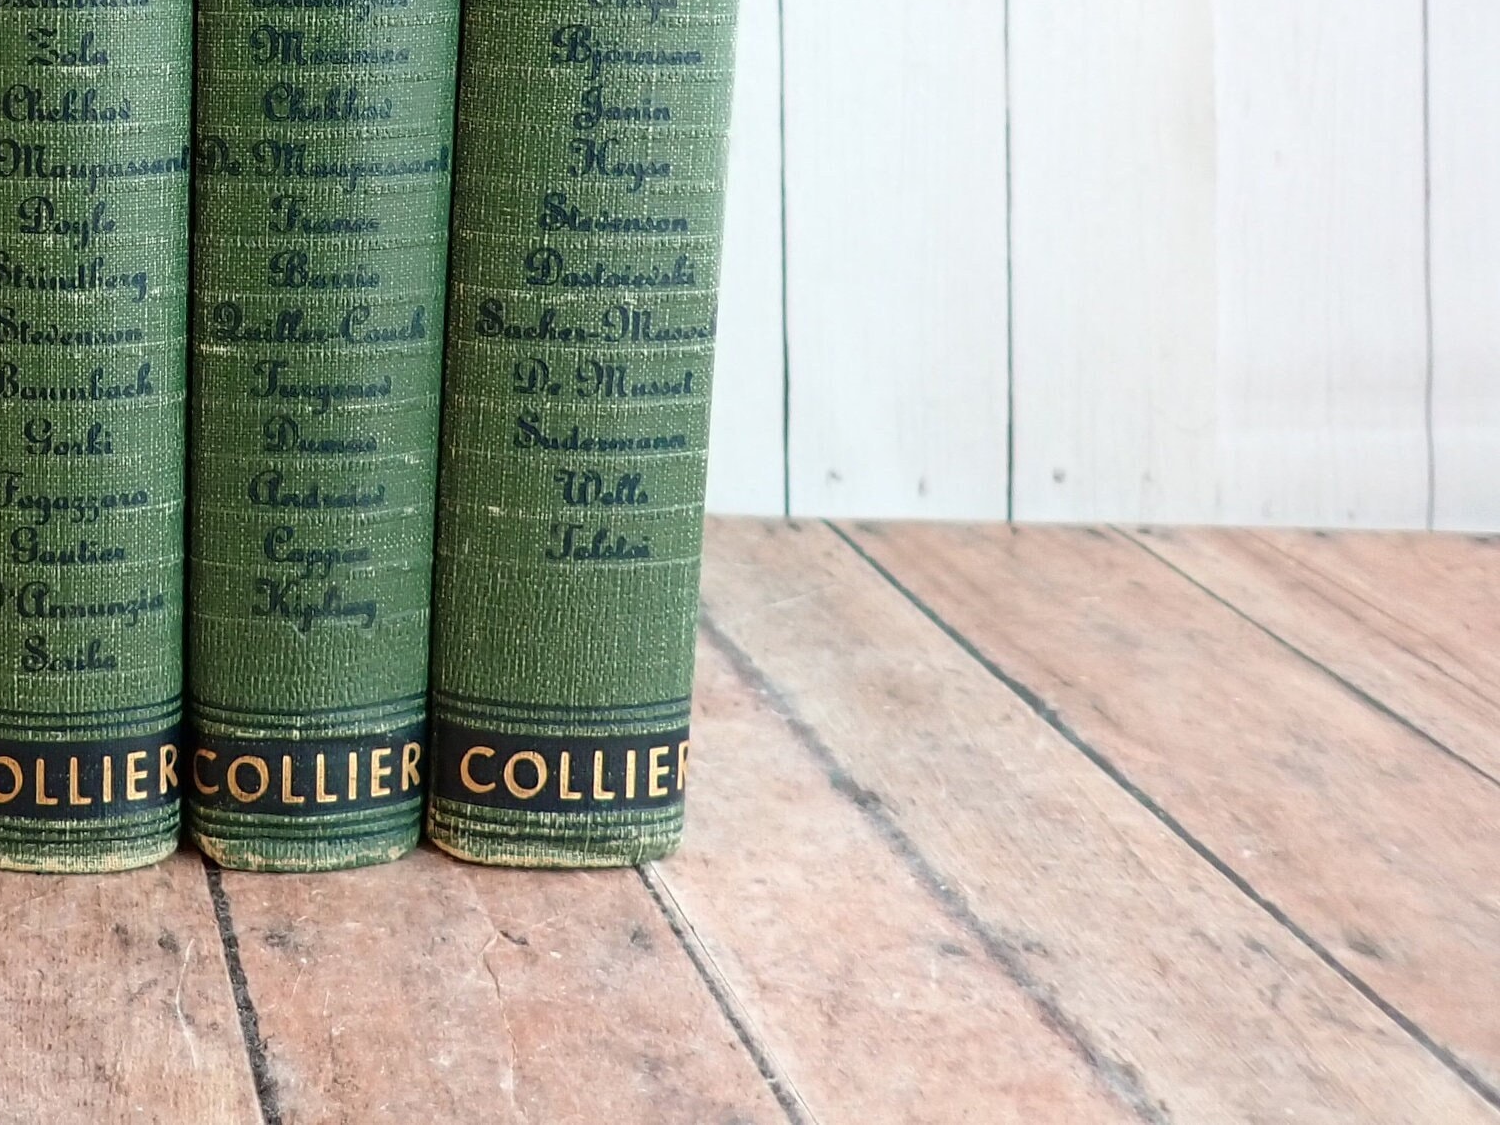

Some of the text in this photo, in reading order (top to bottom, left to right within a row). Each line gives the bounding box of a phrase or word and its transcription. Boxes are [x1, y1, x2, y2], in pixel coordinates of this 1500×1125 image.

[26, 26, 109, 66] Zola
[2, 83, 132, 123] Chekhov
[18, 196, 116, 250] Doyle
[539, 192, 689, 233] Stevenson
[513, 357, 562, 395] De
[23, 418, 114, 456] Gorki
[513, 411, 686, 450] Sudermann
[553, 469, 649, 506] Wells
[9, 526, 126, 566] Gautier
[20, 634, 118, 673] Scribe
[193, 741, 421, 804] COLLIER
